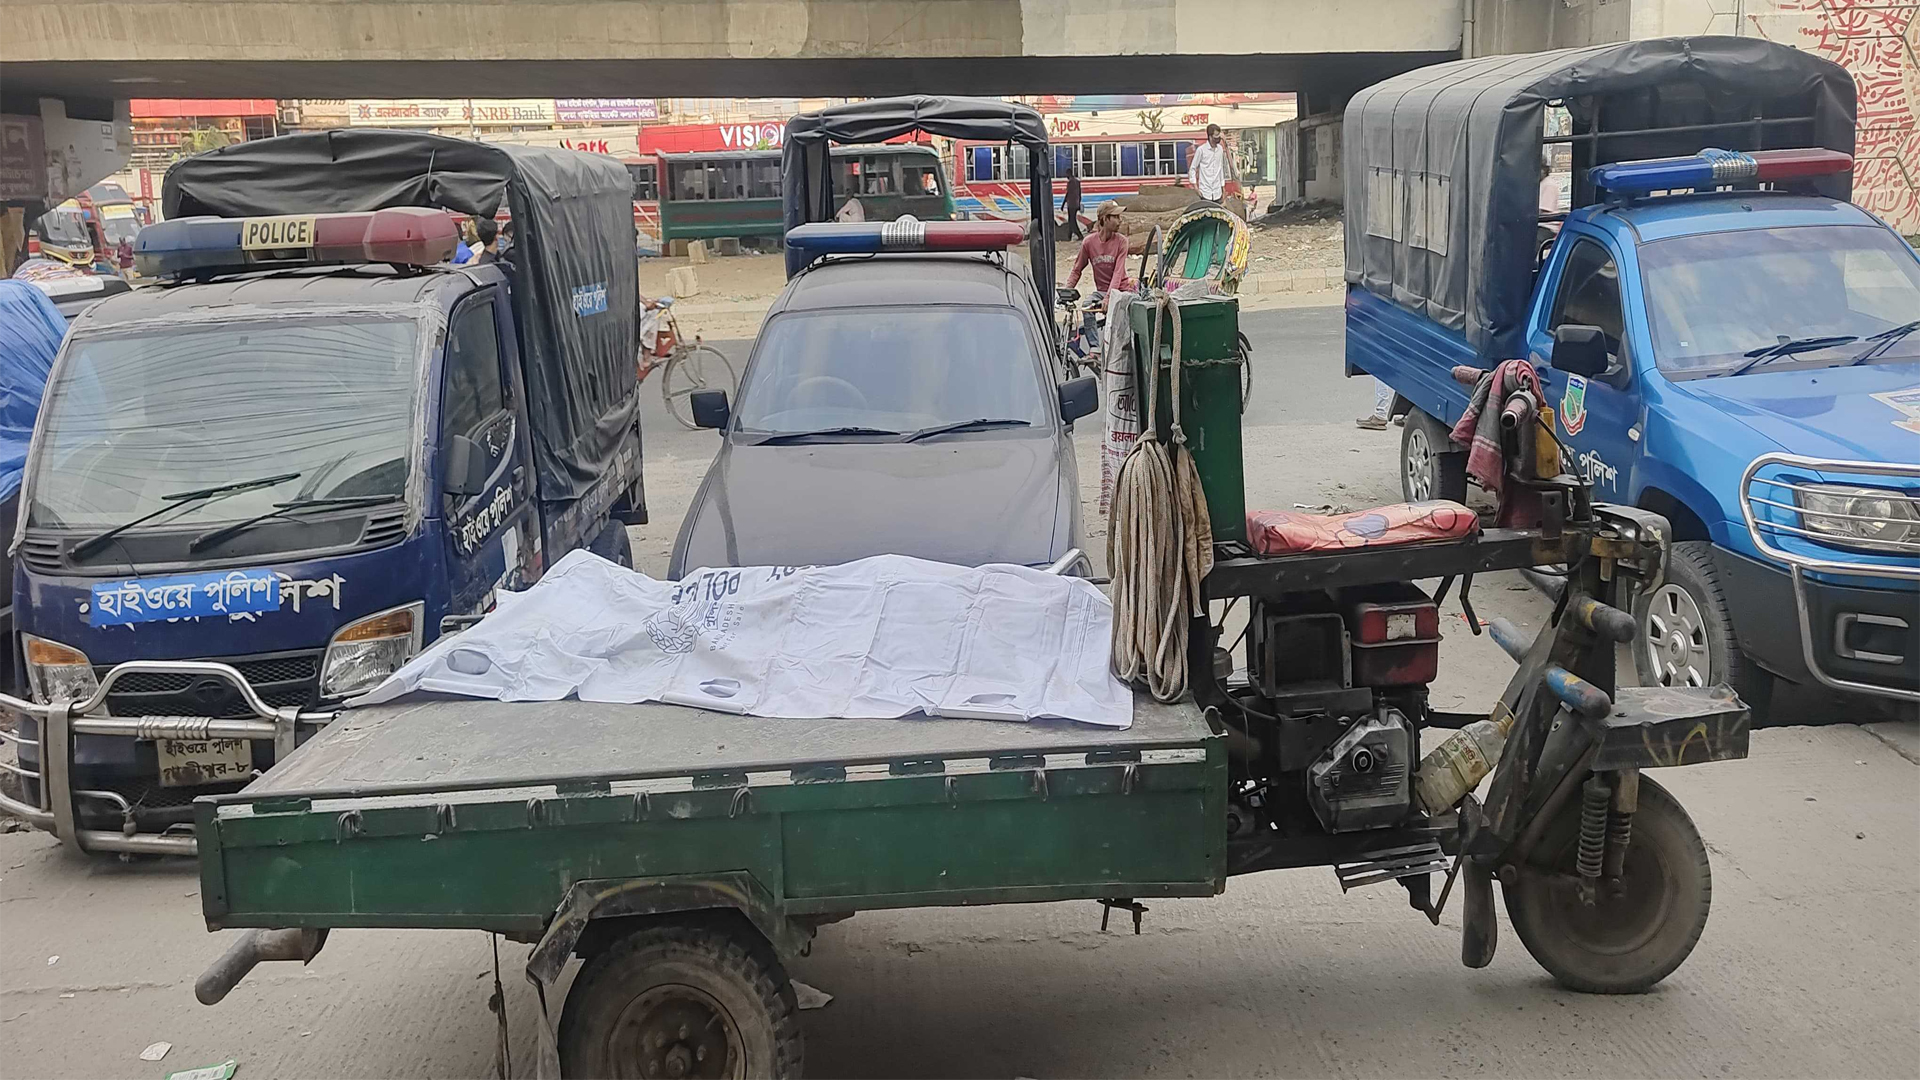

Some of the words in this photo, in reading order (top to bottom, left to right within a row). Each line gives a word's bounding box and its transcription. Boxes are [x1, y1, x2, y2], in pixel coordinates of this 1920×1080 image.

[478, 107, 510, 121] NRB
[513, 104, 547, 120] Bank
[1051, 117, 1080, 135] Apex
[249, 221, 307, 245] POLICE
[96, 582, 197, 617] হাইওয়ে
[204, 571, 273, 611] পুলিশ
